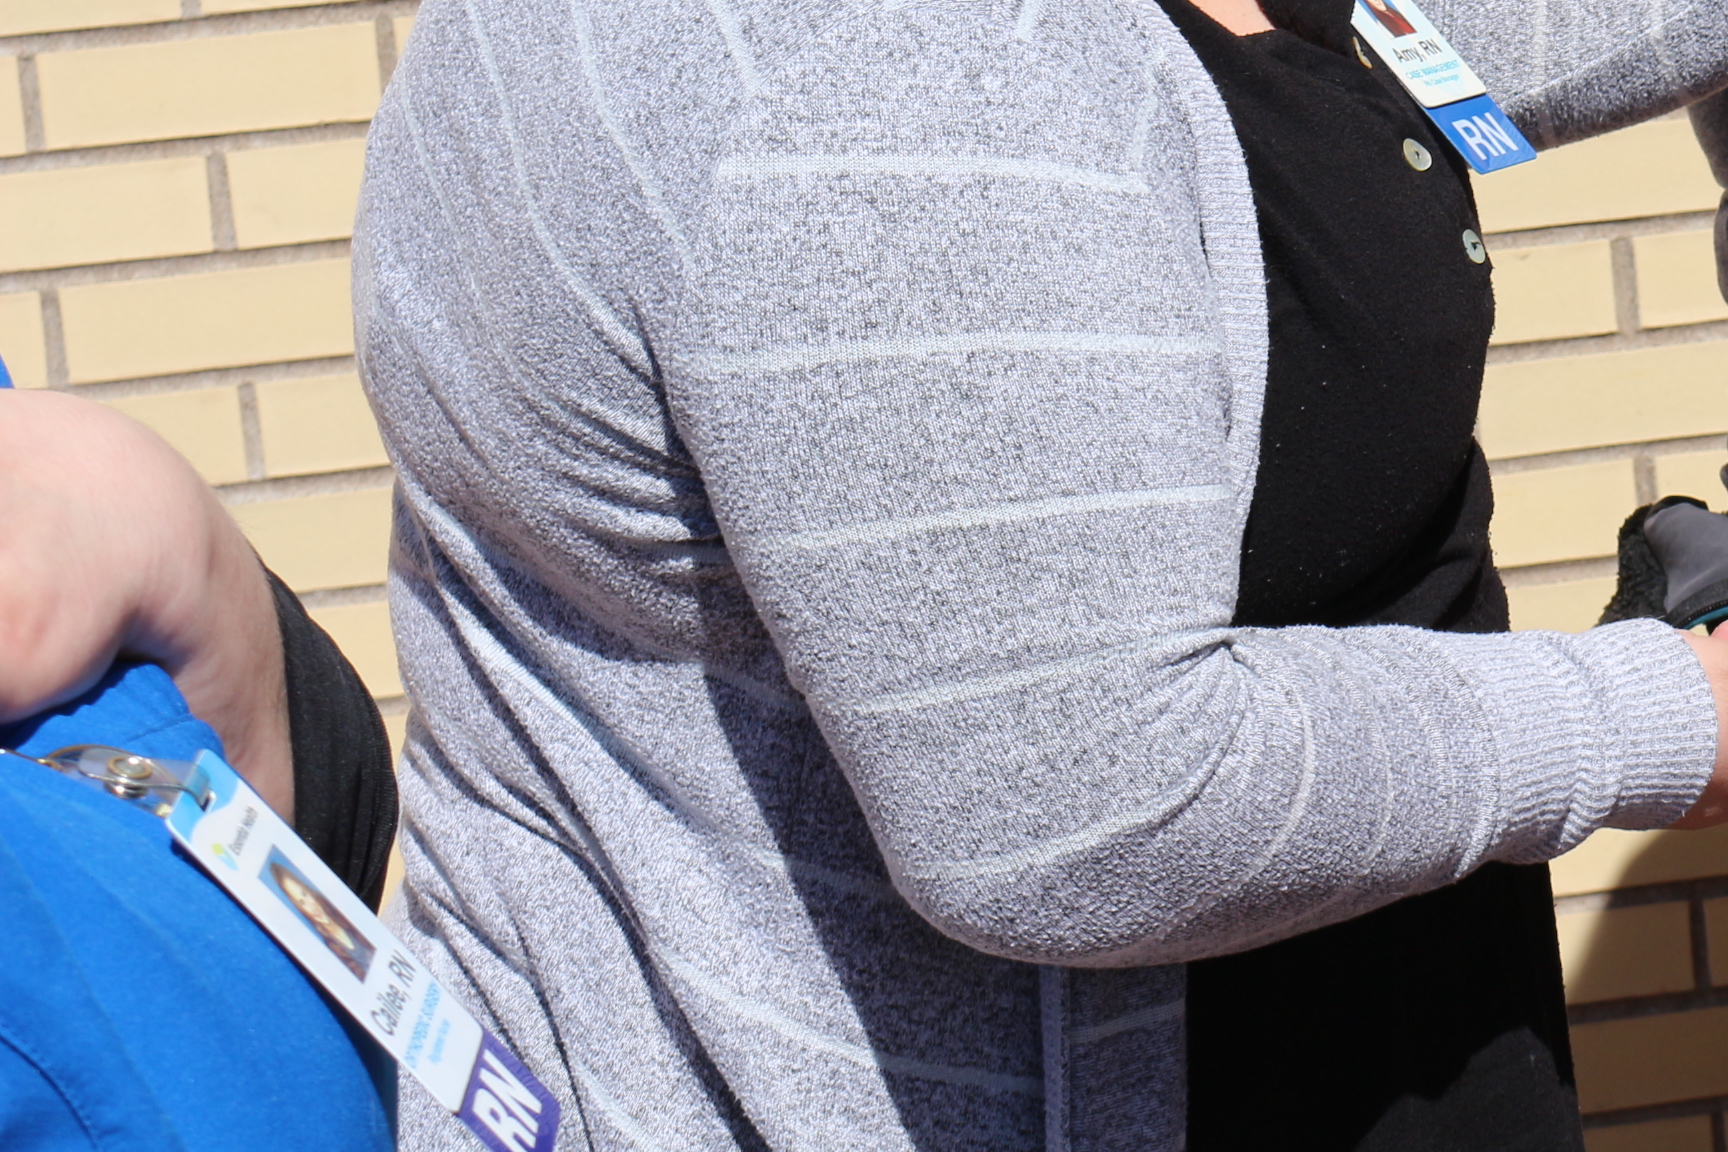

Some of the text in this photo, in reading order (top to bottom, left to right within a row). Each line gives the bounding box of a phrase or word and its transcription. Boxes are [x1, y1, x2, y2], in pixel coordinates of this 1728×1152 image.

[1392, 38, 1443, 63] Amy, RN
[1451, 112, 1519, 160] RN
[388, 948, 417, 989] RN
[472, 1048, 542, 1152] RN
